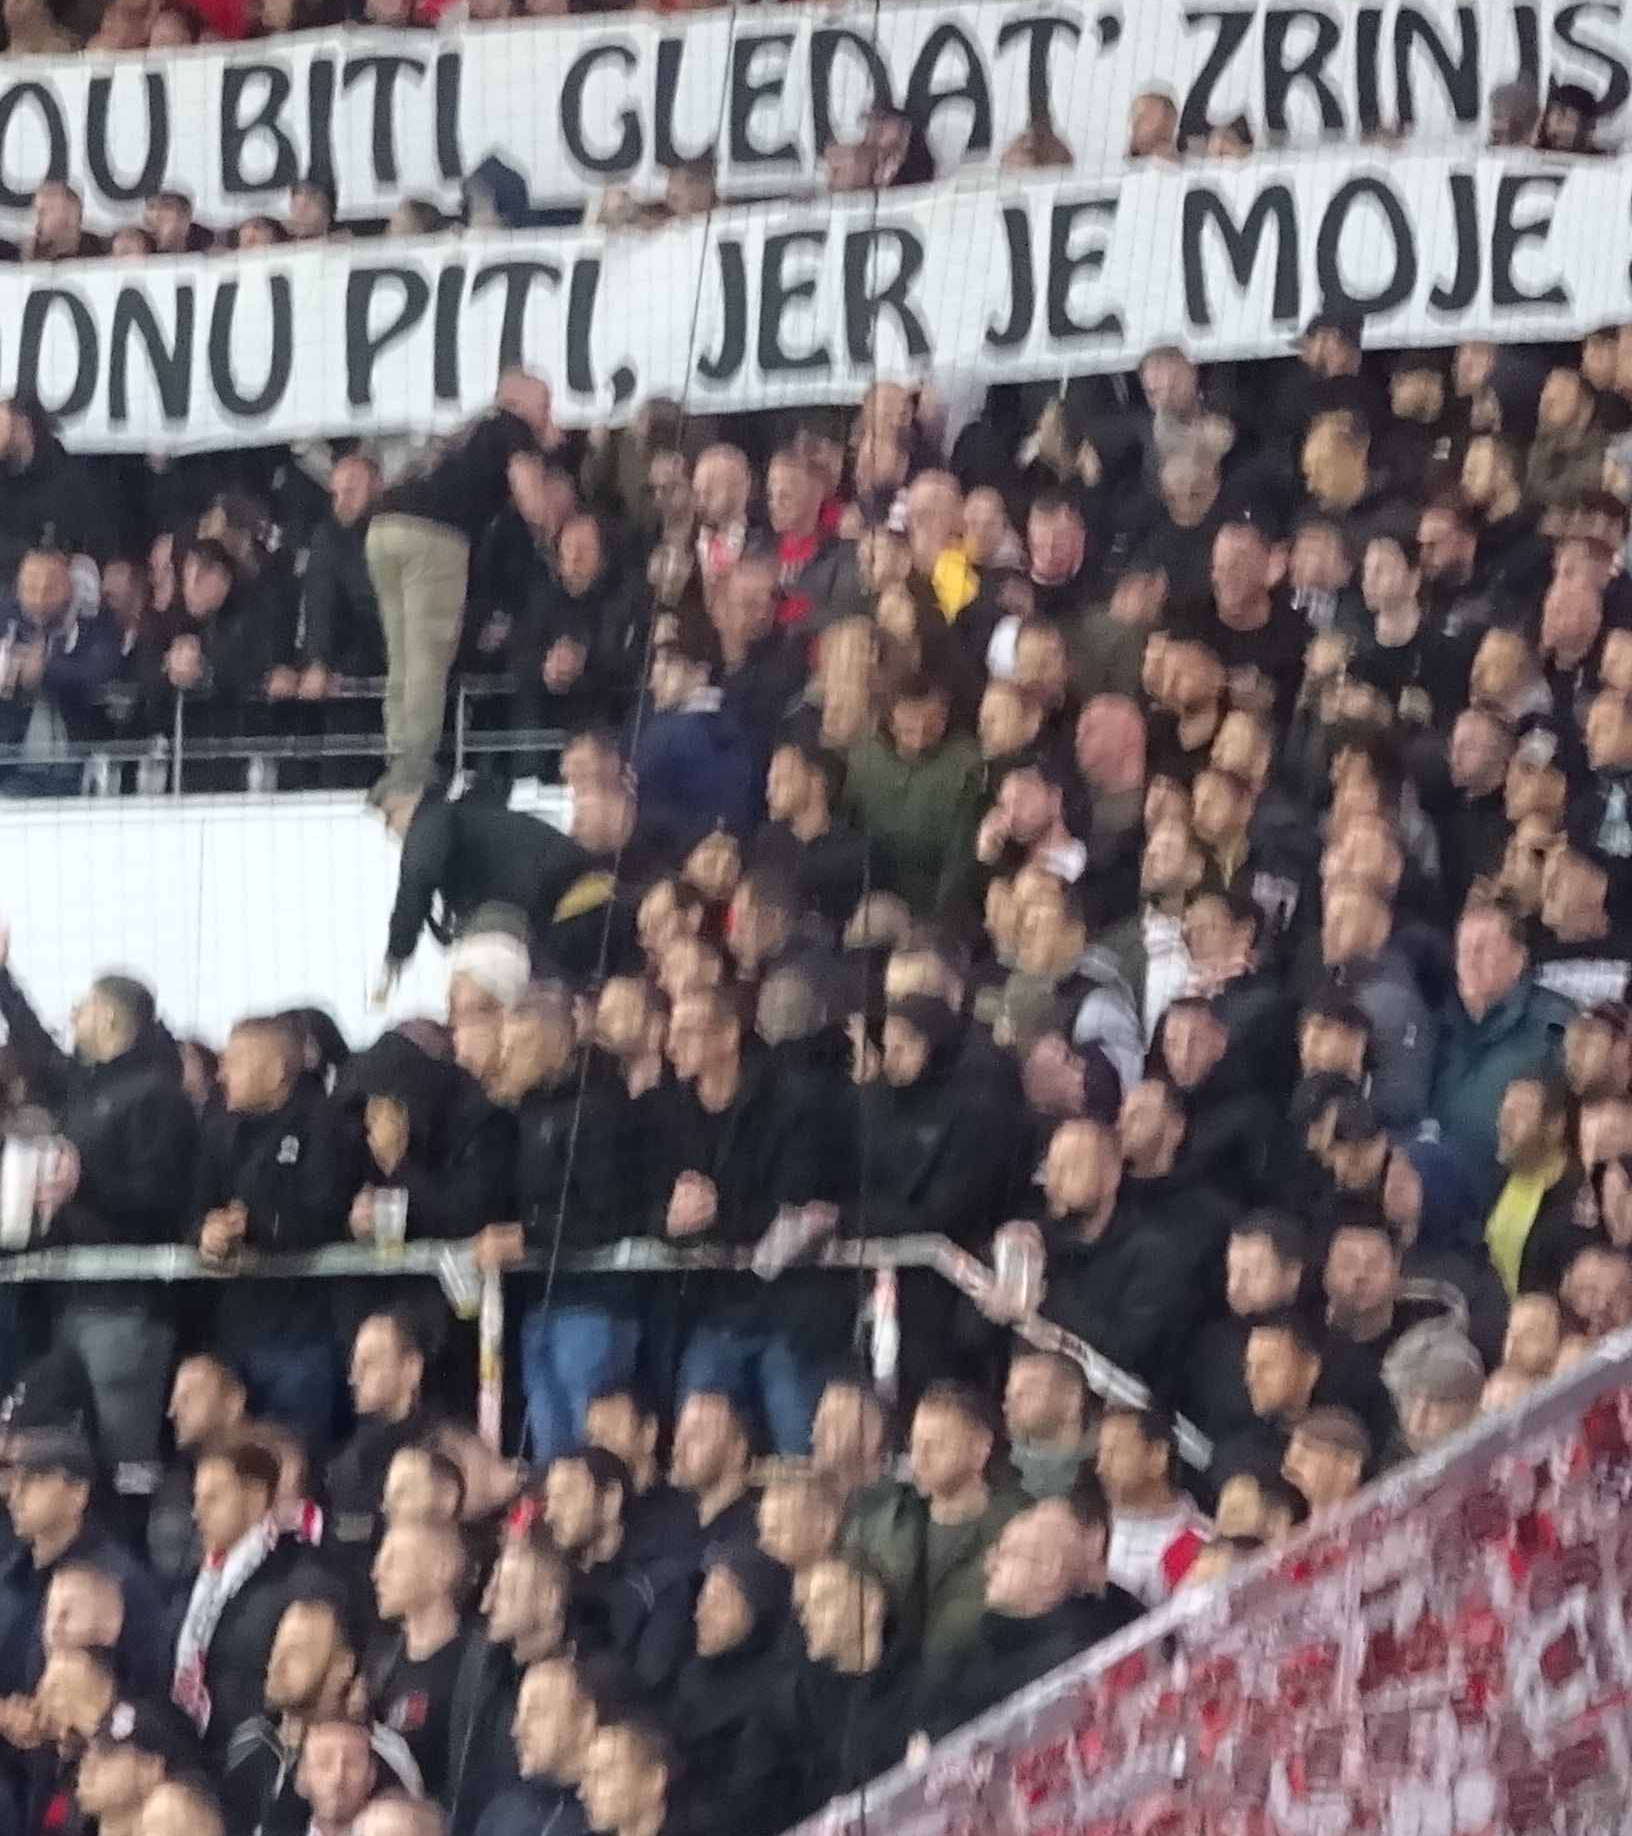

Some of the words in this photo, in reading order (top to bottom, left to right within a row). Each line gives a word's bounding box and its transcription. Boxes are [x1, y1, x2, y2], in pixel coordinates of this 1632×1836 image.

[220, 51, 462, 194] BITI
[345, 258, 636, 406] PITI,
[698, 227, 931, 379] JER
[984, 200, 1125, 346] JE
[1181, 172, 1571, 326] MOJE
